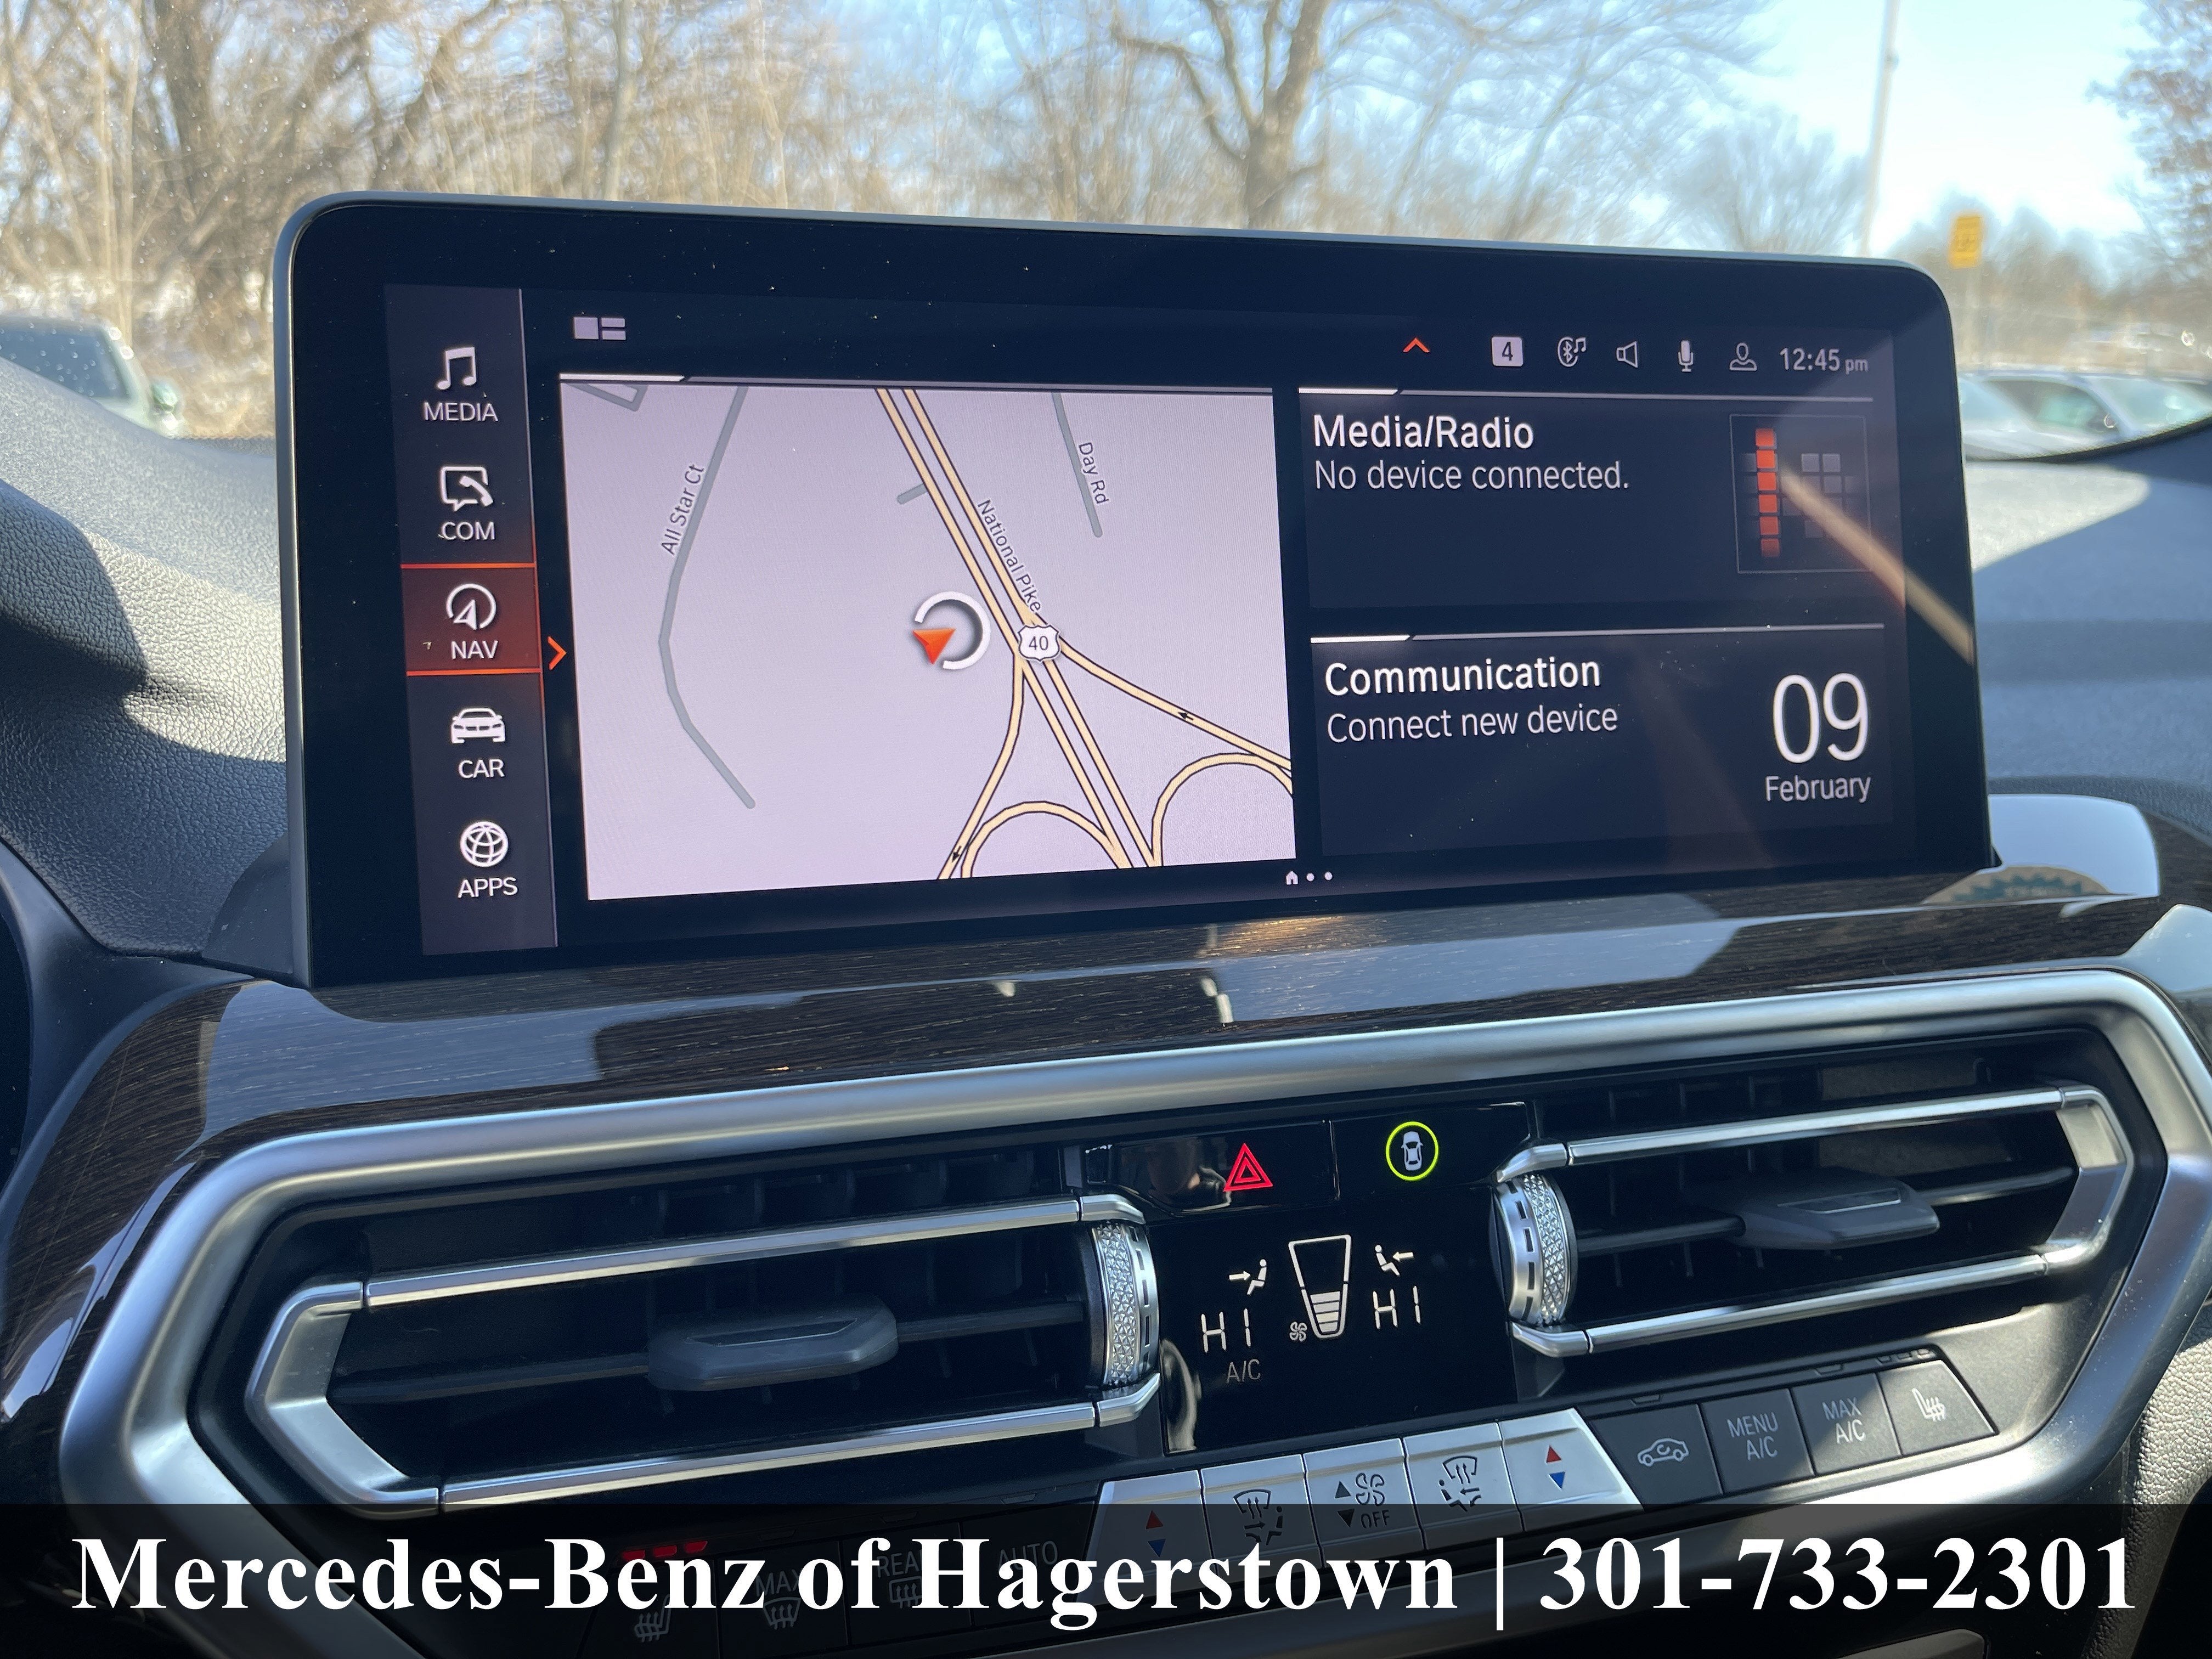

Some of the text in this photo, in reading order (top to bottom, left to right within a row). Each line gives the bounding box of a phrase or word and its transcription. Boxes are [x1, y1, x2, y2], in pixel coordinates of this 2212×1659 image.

[1502, 341, 1513, 362] 4
[1780, 348, 1869, 374] 12:45 pm
[424, 402, 498, 422] MEDIA
[1314, 415, 1534, 449] Media/Radio
[1079, 442, 1109, 504] Day Rd
[1316, 460, 1629, 489] No device connected.
[662, 464, 704, 555] All Star Ct
[442, 522, 495, 540] COM
[978, 499, 1041, 612] National Pike
[451, 640, 498, 659] NAV
[1029, 636, 1048, 651] 40
[1325, 657, 1601, 696] Communication
[1328, 703, 1618, 742] Connect new device
[1773, 673, 1868, 763] 09
[458, 759, 505, 778] CAR
[1765, 775, 1871, 803] February
[458, 877, 518, 898] APPS
[1373, 1285, 1420, 1329] HI
[1201, 1308, 1251, 1353] HI
[1226, 1358, 1261, 1383] A/C
[1822, 1397, 1861, 1420] MAX
[1728, 1412, 1778, 1437] MENU
[1836, 1419, 1865, 1443] A/C
[1747, 1436, 1778, 1461] A/C
[1361, 1510, 1390, 1528] OFF
[877, 1549, 922, 1578] REA
